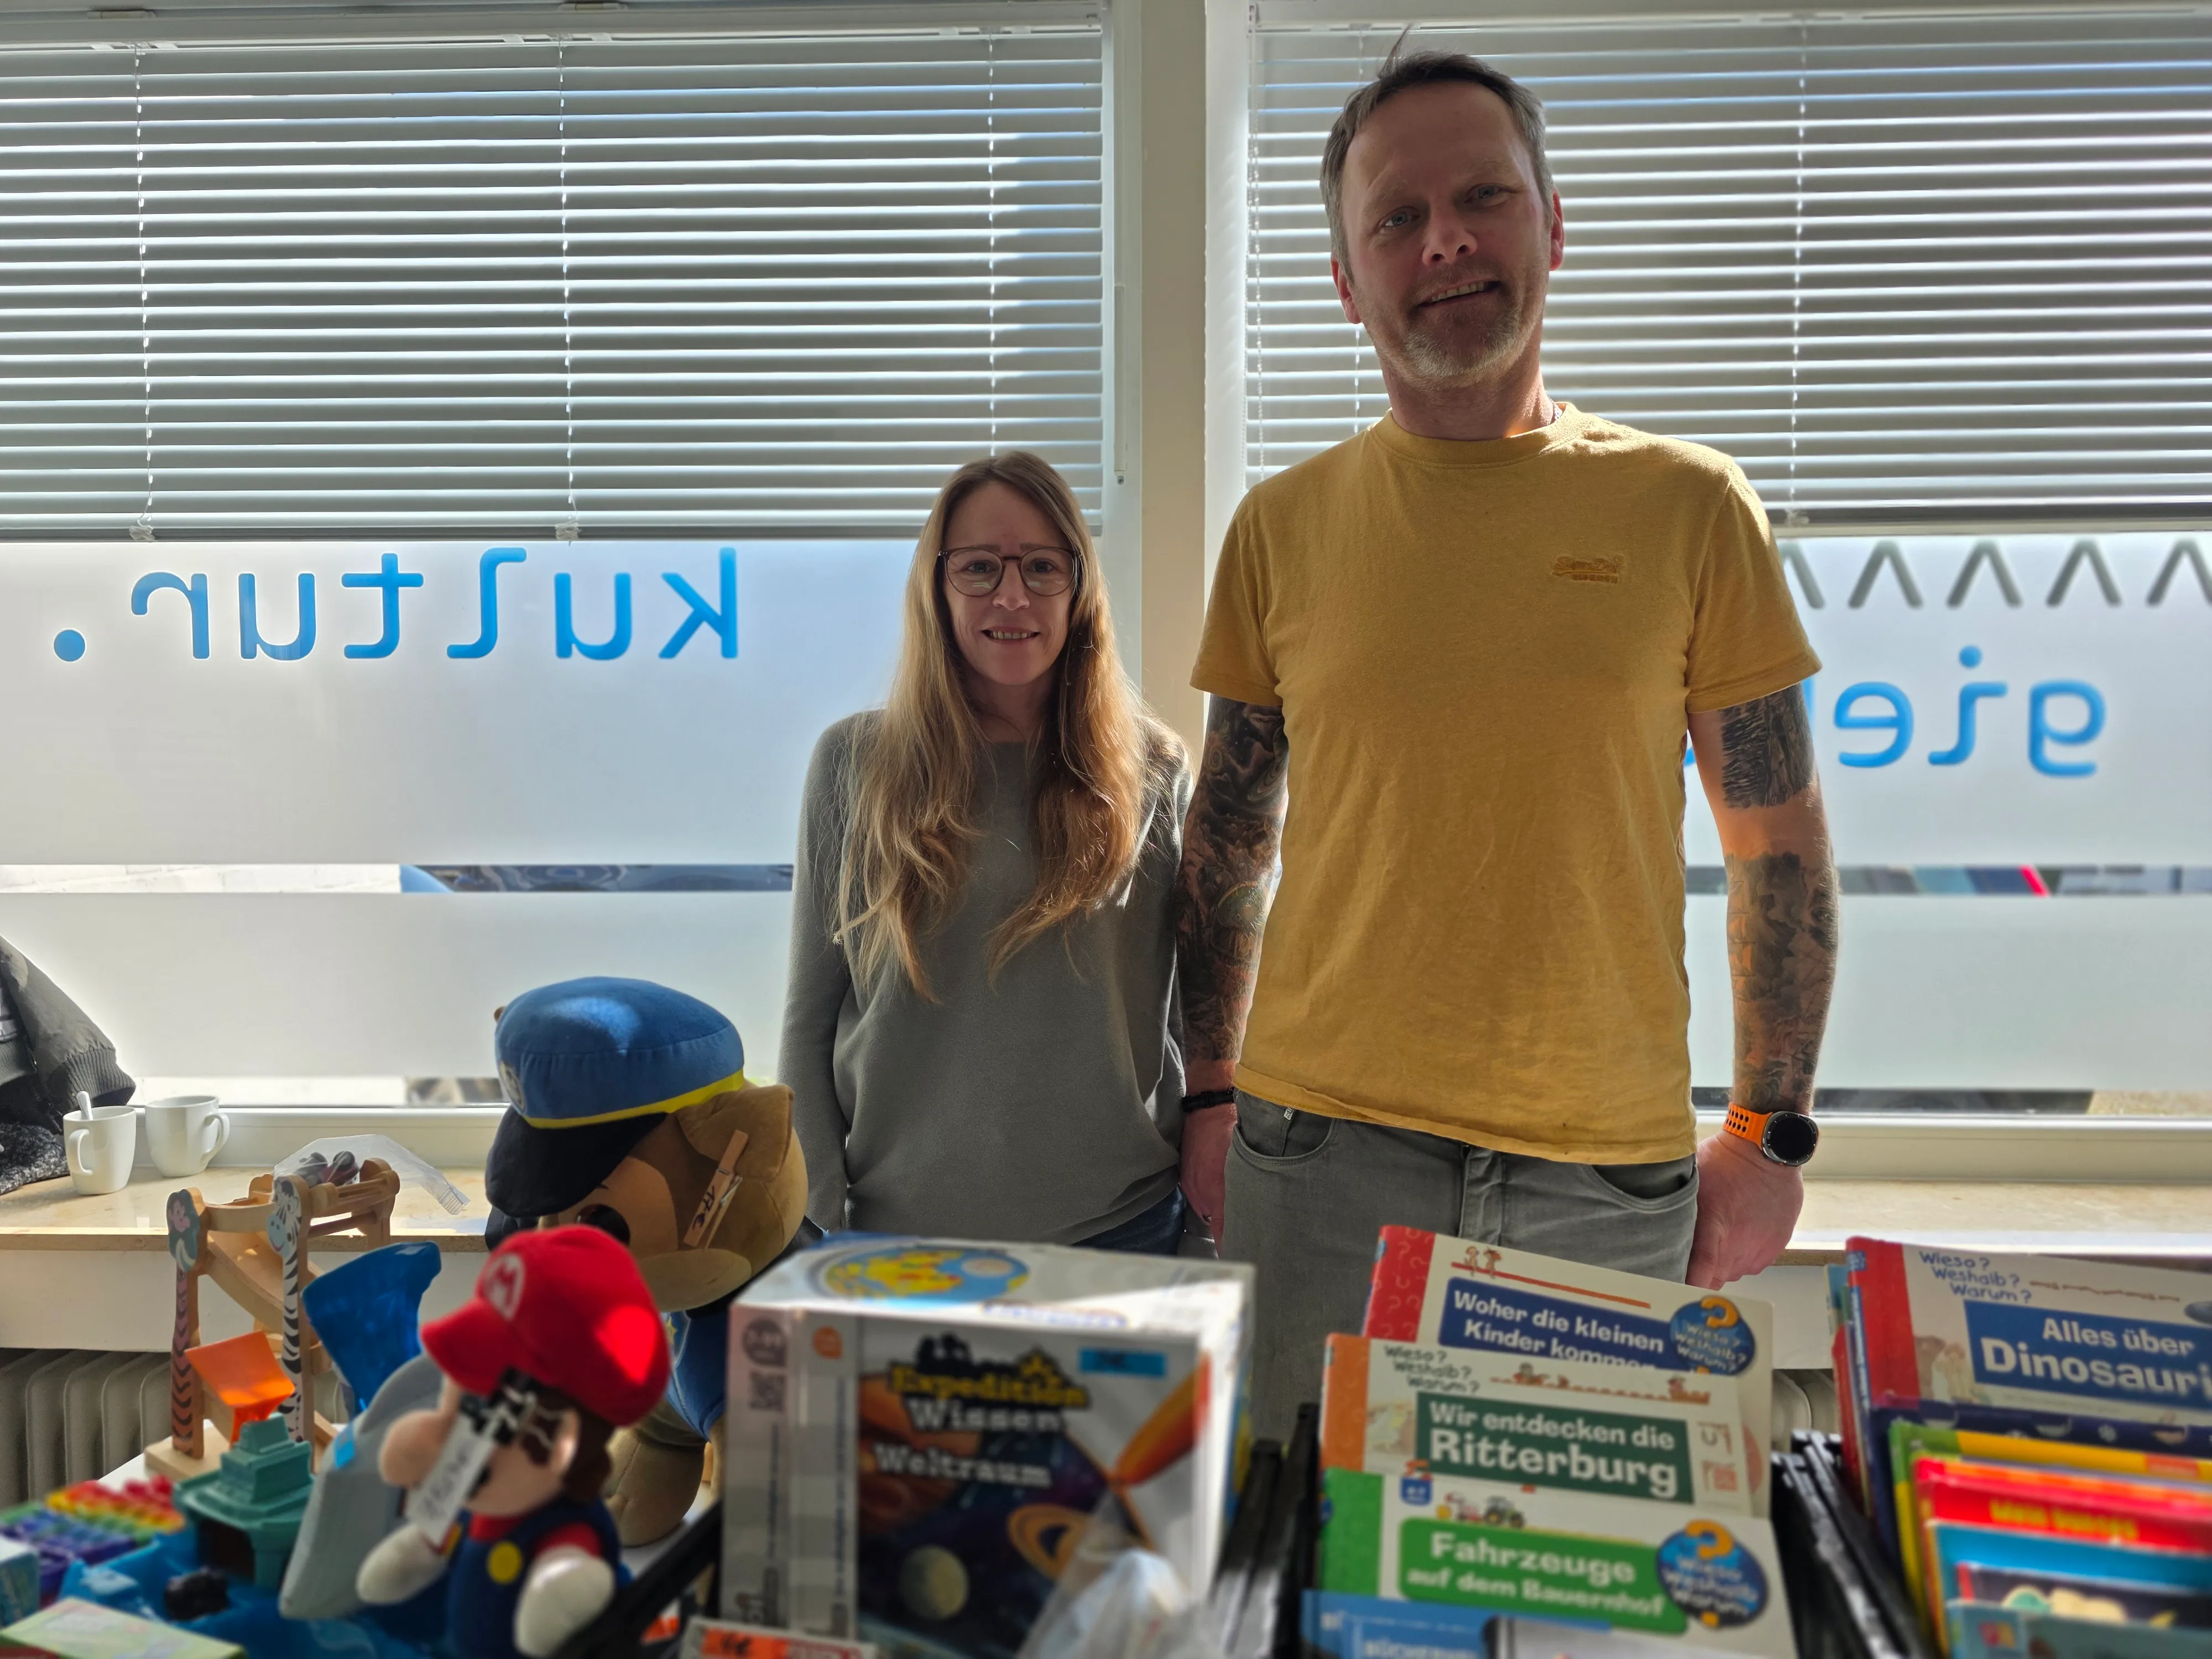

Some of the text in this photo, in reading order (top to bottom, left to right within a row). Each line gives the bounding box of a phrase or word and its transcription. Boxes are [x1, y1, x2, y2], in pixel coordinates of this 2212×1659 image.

[1931, 1265, 2020, 1288] Weshalb?
[1950, 1282, 2032, 1304] Warum?
[1453, 1290, 1664, 1354] Woher die kleinen
[1464, 1319, 1656, 1369] Kinder komm
[2042, 1318, 2195, 1357] Alles über
[891, 1363, 1088, 1407] Expedition
[1980, 1337, 2212, 1402] Dinosauri
[906, 1396, 1062, 1431] Wissen
[1428, 1400, 1675, 1451] Wir entdecken die
[873, 1442, 1052, 1487] Weltraum
[1430, 1428, 1678, 1499] Ritterburg
[1430, 1530, 1637, 1588] Fahrzeuge
[1406, 1567, 1668, 1618] auf dem Bauernhof
